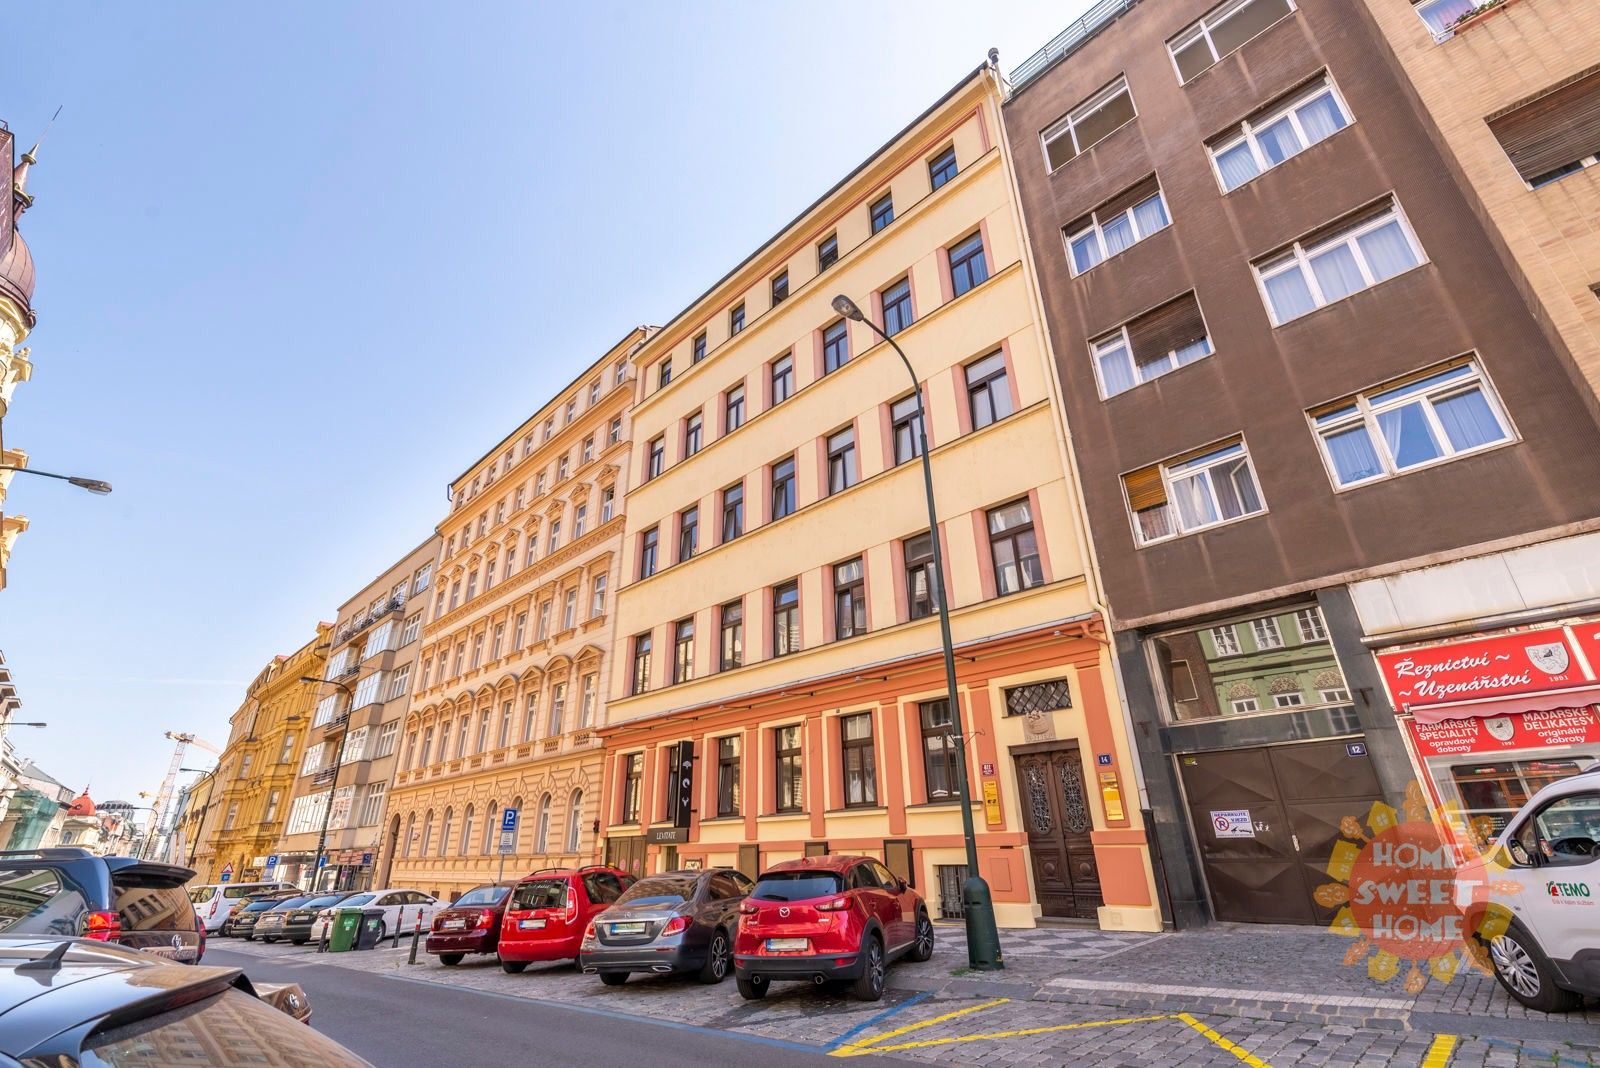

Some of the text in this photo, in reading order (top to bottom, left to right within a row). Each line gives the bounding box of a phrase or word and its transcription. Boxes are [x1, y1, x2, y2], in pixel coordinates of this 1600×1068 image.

[1394, 652, 1490, 678] Řeznictví
[1414, 670, 1531, 698] Uzenářství
[1523, 716, 1594, 730] DELIKATESY
[1420, 728, 1478, 741] SPECIALITY
[1538, 727, 1586, 737] originální
[1429, 737, 1476, 747] opravdové
[1545, 736, 1585, 744] dobroty
[1437, 745, 1471, 753] dobroty
